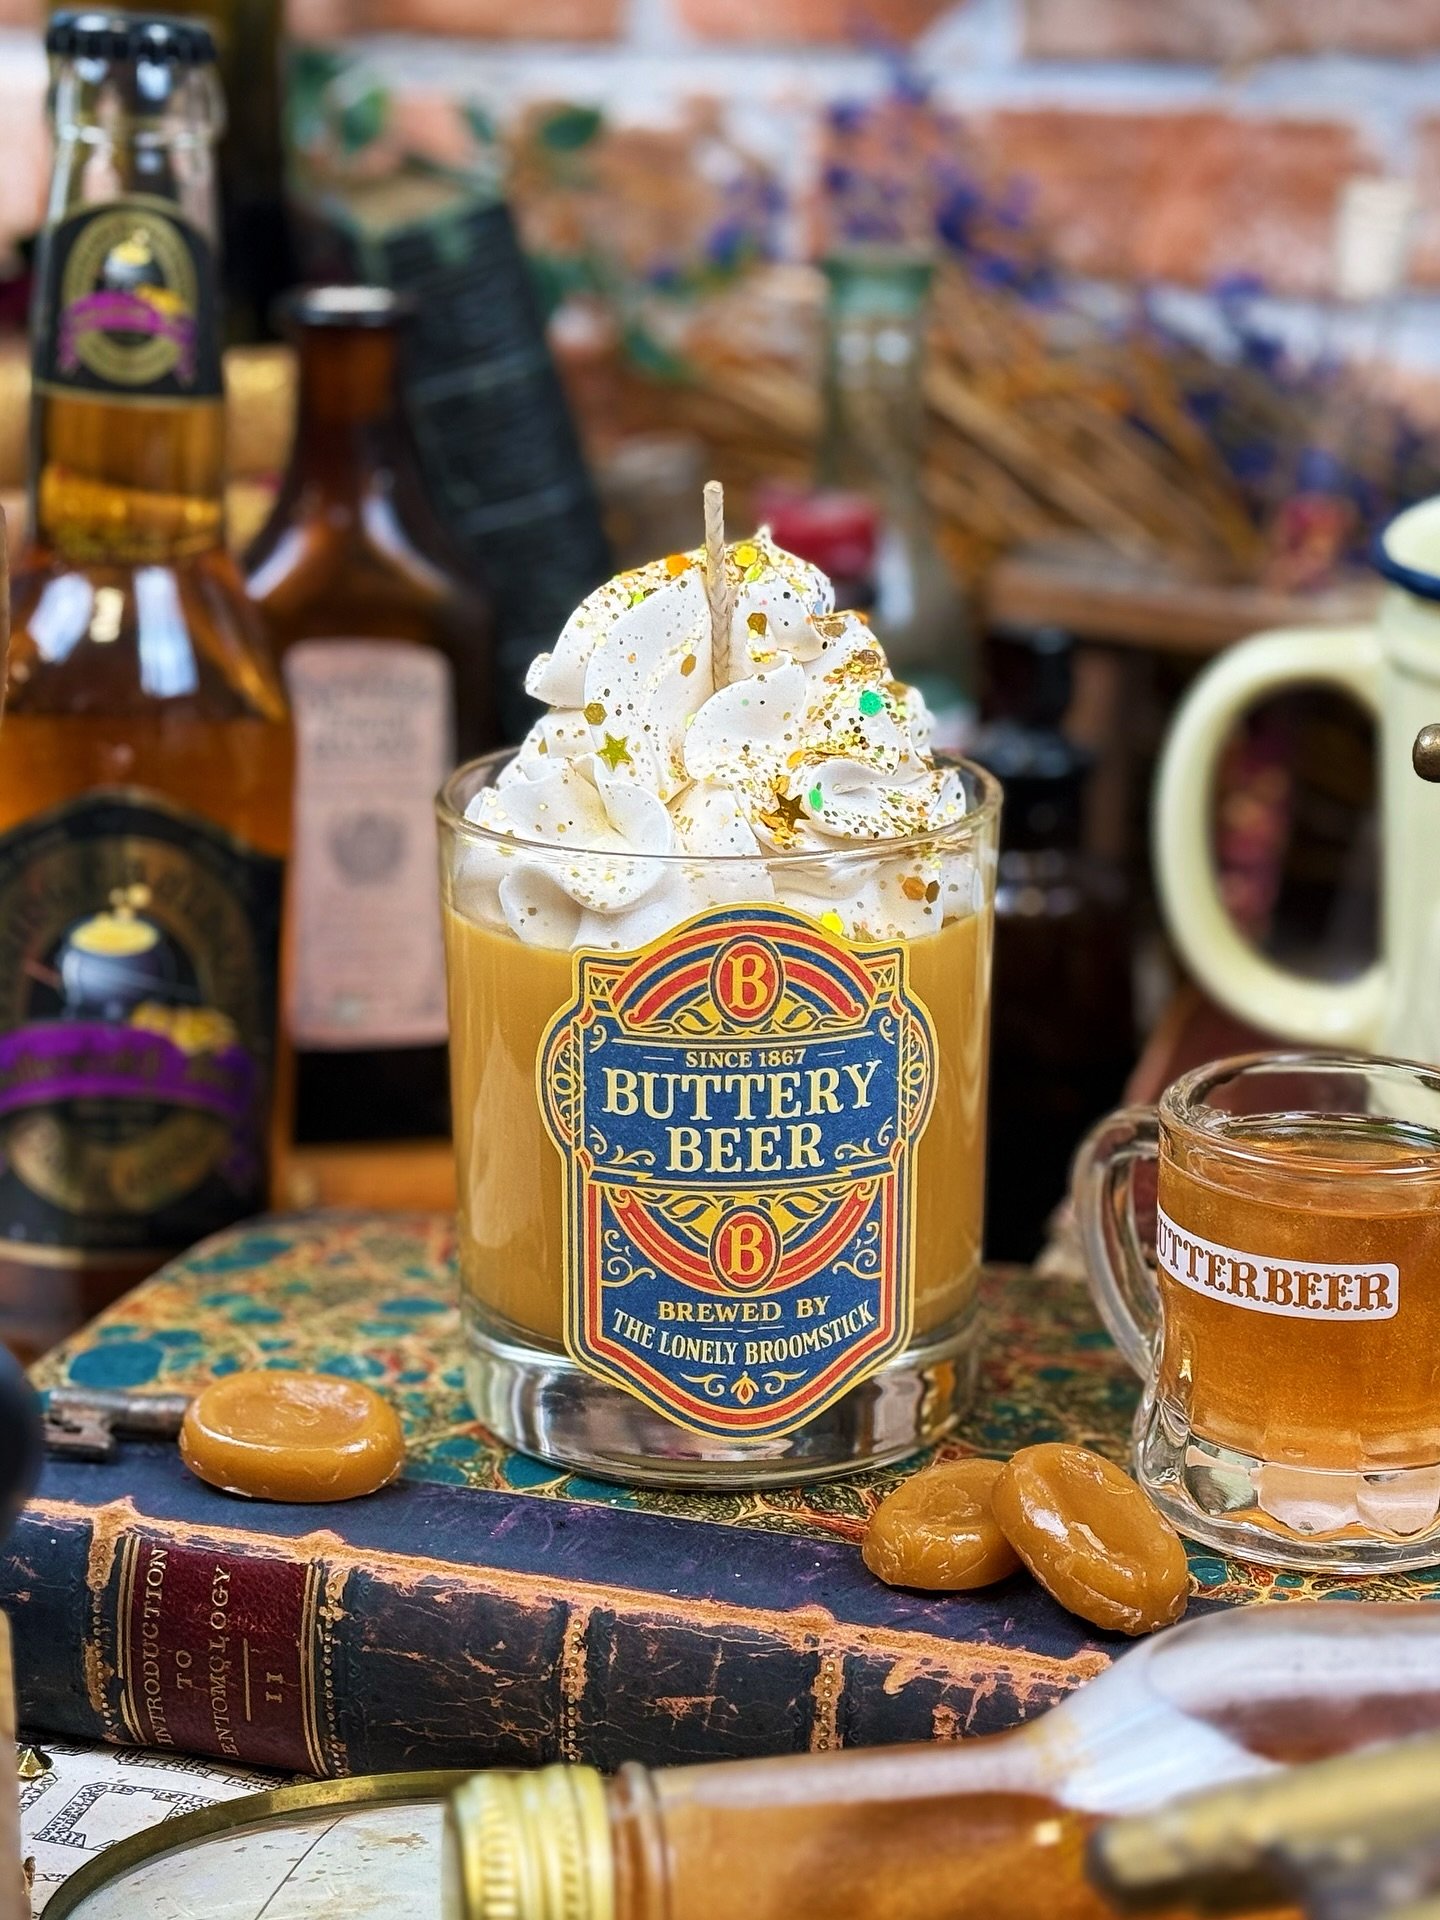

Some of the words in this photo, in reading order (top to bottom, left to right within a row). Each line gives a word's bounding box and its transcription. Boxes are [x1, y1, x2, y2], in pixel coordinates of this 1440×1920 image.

[728, 953, 769, 1011] B
[685, 1051, 752, 1068] SINCE
[759, 1048, 807, 1067] 1867
[601, 1059, 883, 1122] BUTTERY
[665, 1122, 826, 1174] BEER
[726, 1223, 764, 1277] B
[1157, 1215, 1393, 1313] UTTERBEER
[611, 1308, 656, 1348] THE
[657, 1331, 738, 1366] LONELY
[744, 1301, 877, 1367] BROOMSTICK
[657, 1300, 783, 1324] BREWED
[796, 1296, 831, 1319] BY
[141, 1547, 175, 1746] INTRODUCTION
[175, 1650, 193, 1690] TO
[208, 1563, 240, 1757] ENTOMOLOGY
